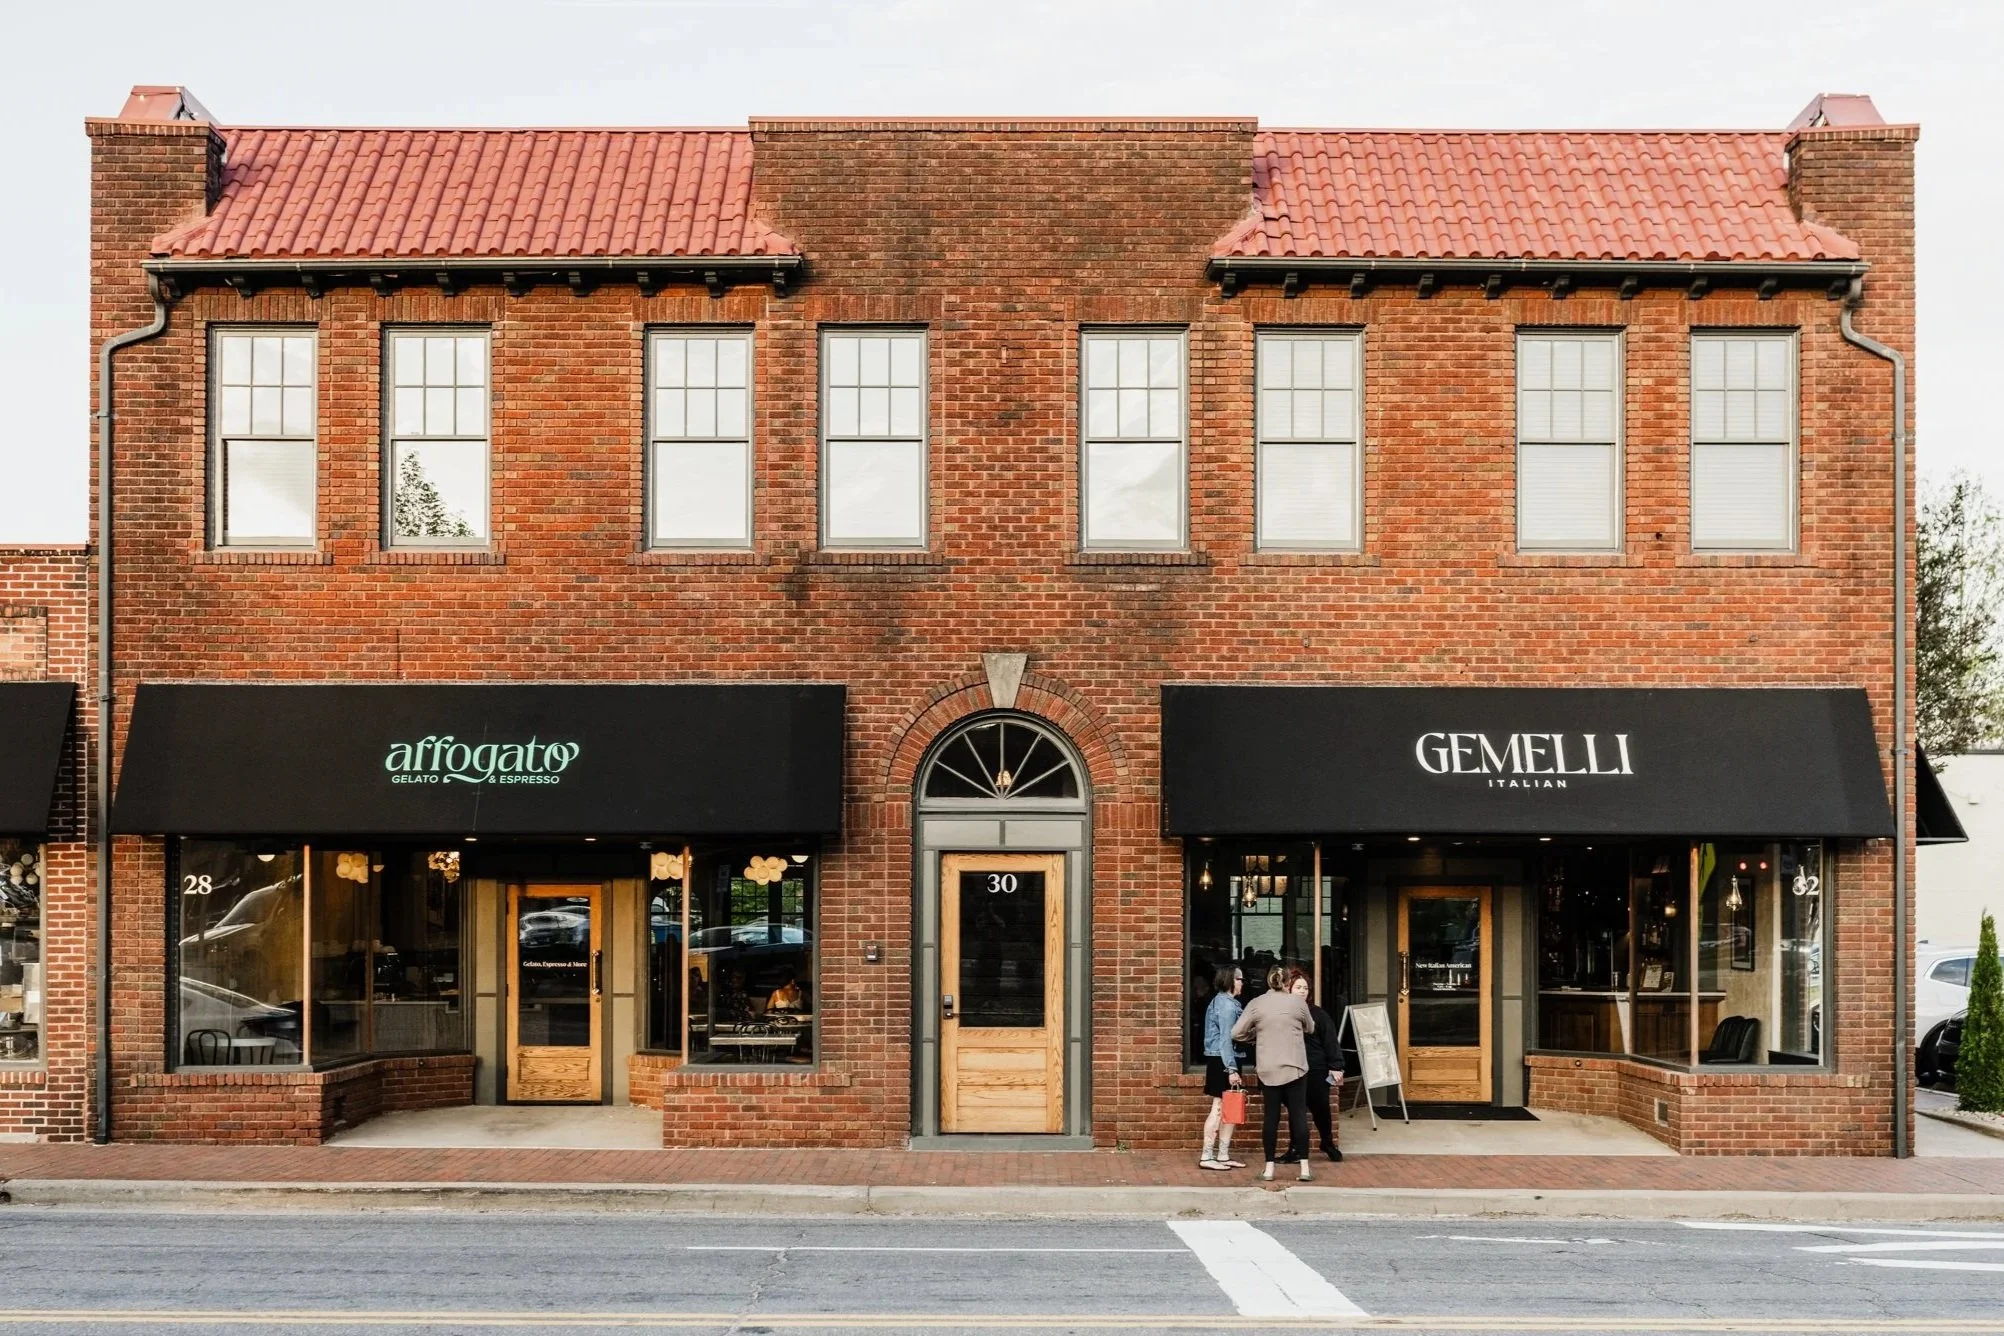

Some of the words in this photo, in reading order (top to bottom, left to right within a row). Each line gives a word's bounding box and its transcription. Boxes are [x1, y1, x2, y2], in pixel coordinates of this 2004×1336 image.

[385, 735, 580, 784] affogato
[1415, 732, 1634, 775] GEMELLI
[391, 774, 439, 784] GELATO
[488, 775, 497, 784] &
[499, 775, 560, 784] ESPRESSO
[1488, 779, 1568, 788] ITALIAN
[183, 874, 213, 895] 28
[987, 873, 1018, 894] 30
